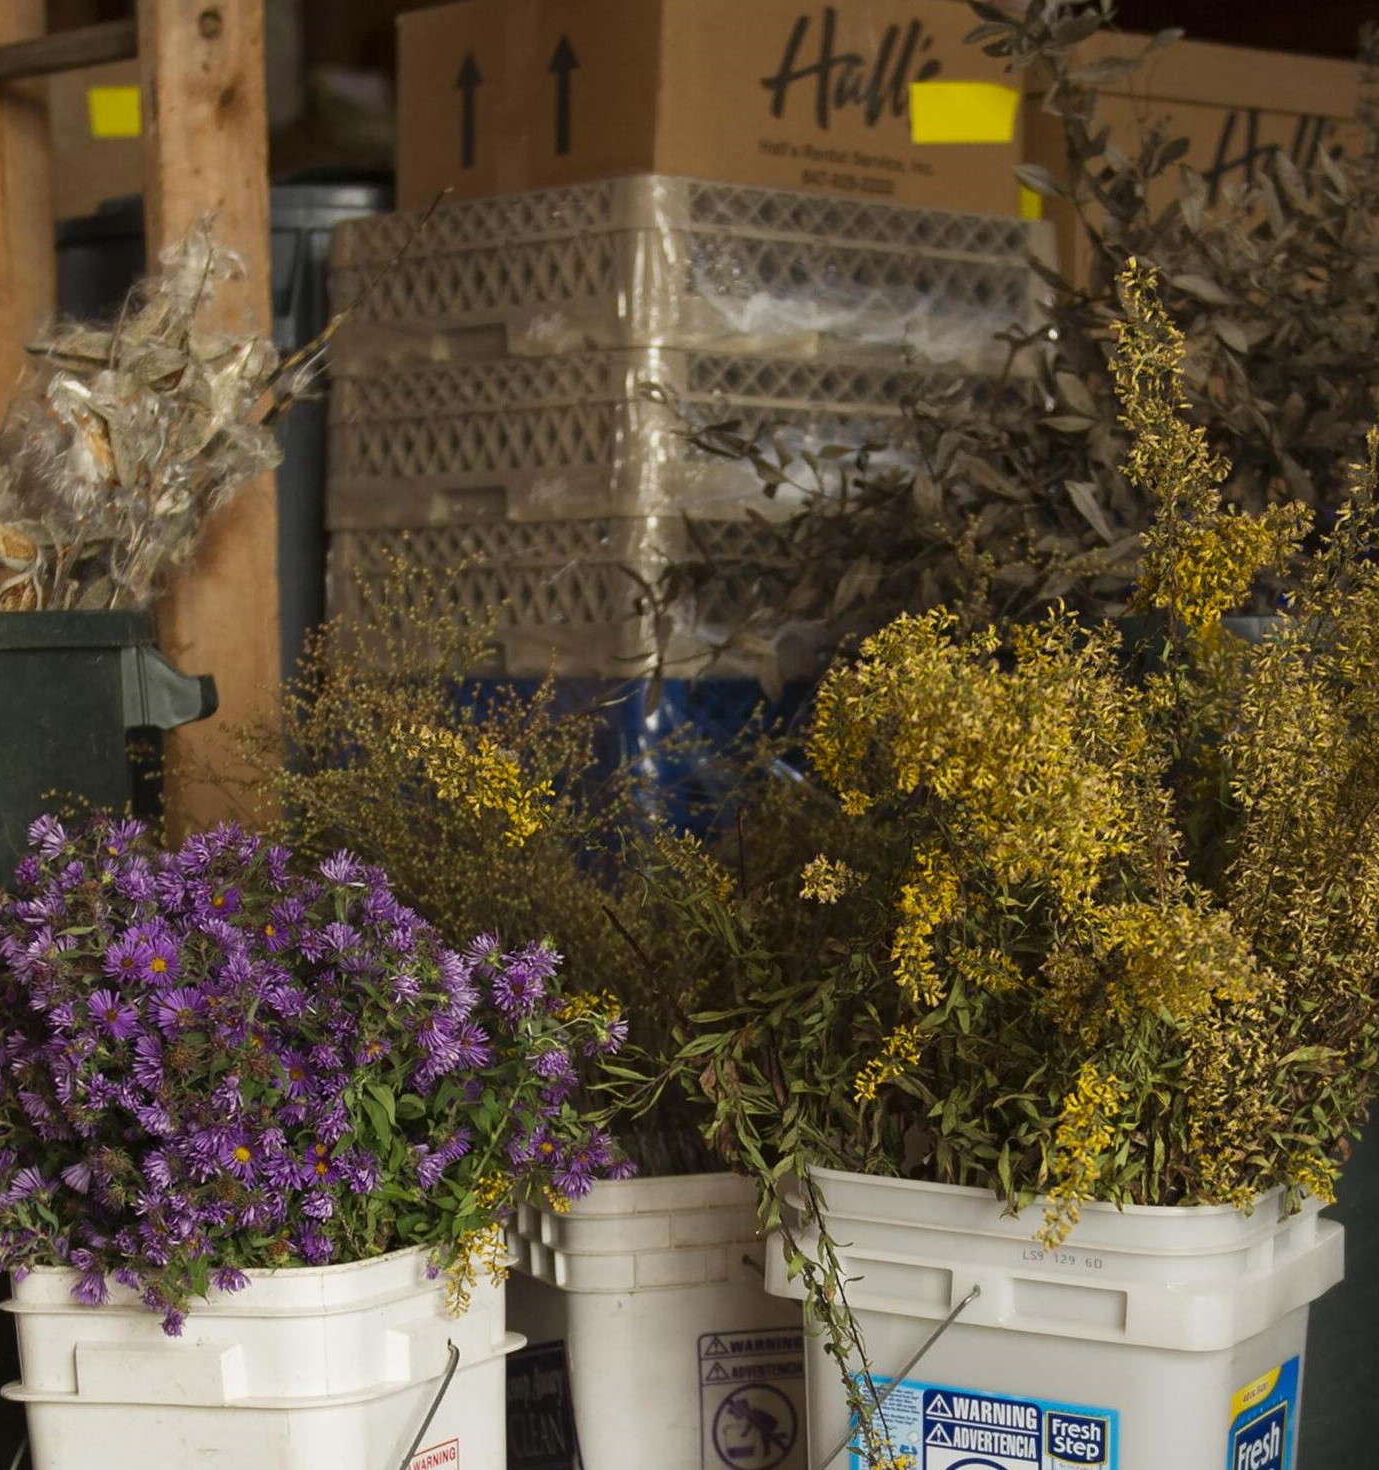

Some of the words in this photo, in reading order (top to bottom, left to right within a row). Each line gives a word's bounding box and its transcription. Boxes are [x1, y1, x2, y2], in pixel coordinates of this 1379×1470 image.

[730, 1337, 804, 1354] WARNING
[953, 1397, 1038, 1430] WARNING
[1052, 1419, 1101, 1442] Fresh
[953, 1426, 1037, 1459] ADVERTENCIA
[1055, 1437, 1099, 1460] Step
[1239, 1421, 1280, 1470] Fresh
[412, 1447, 456, 1470] WARNING
